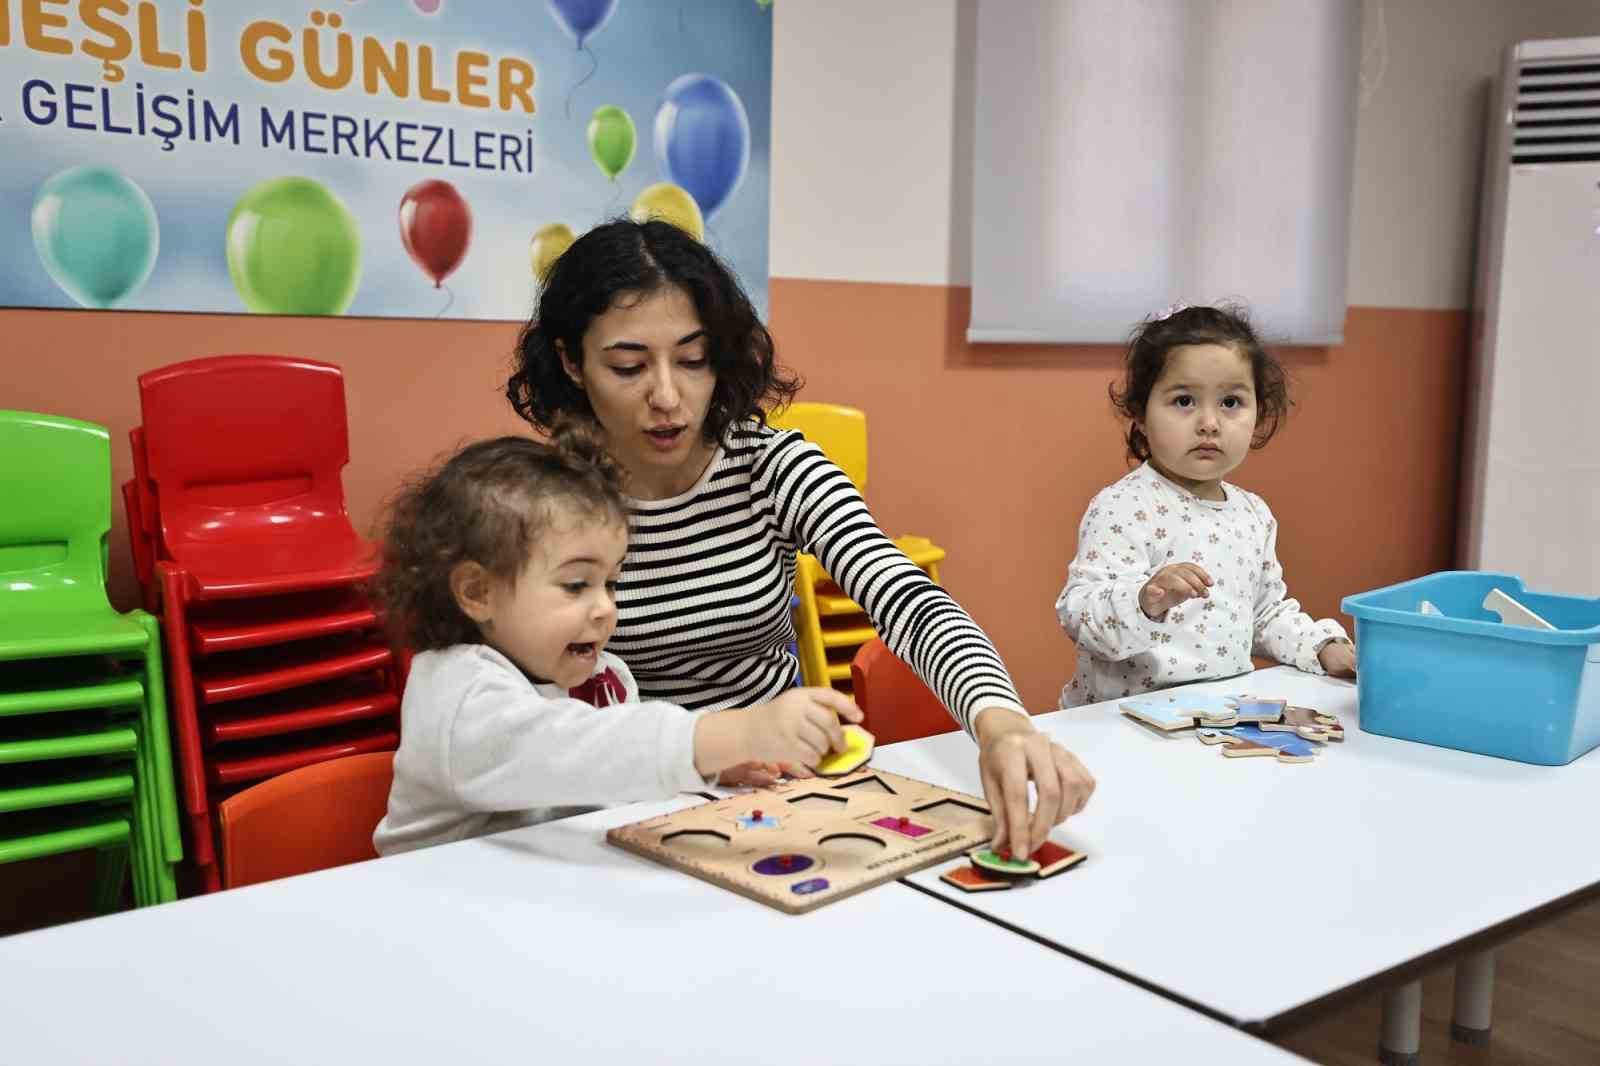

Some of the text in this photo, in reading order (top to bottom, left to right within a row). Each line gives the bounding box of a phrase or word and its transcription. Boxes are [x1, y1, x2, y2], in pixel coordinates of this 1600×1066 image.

[0, 0, 536, 114] EŞLİ GÜNLER
[22, 79, 534, 173] GELİŞİM MERKEZLERİ
